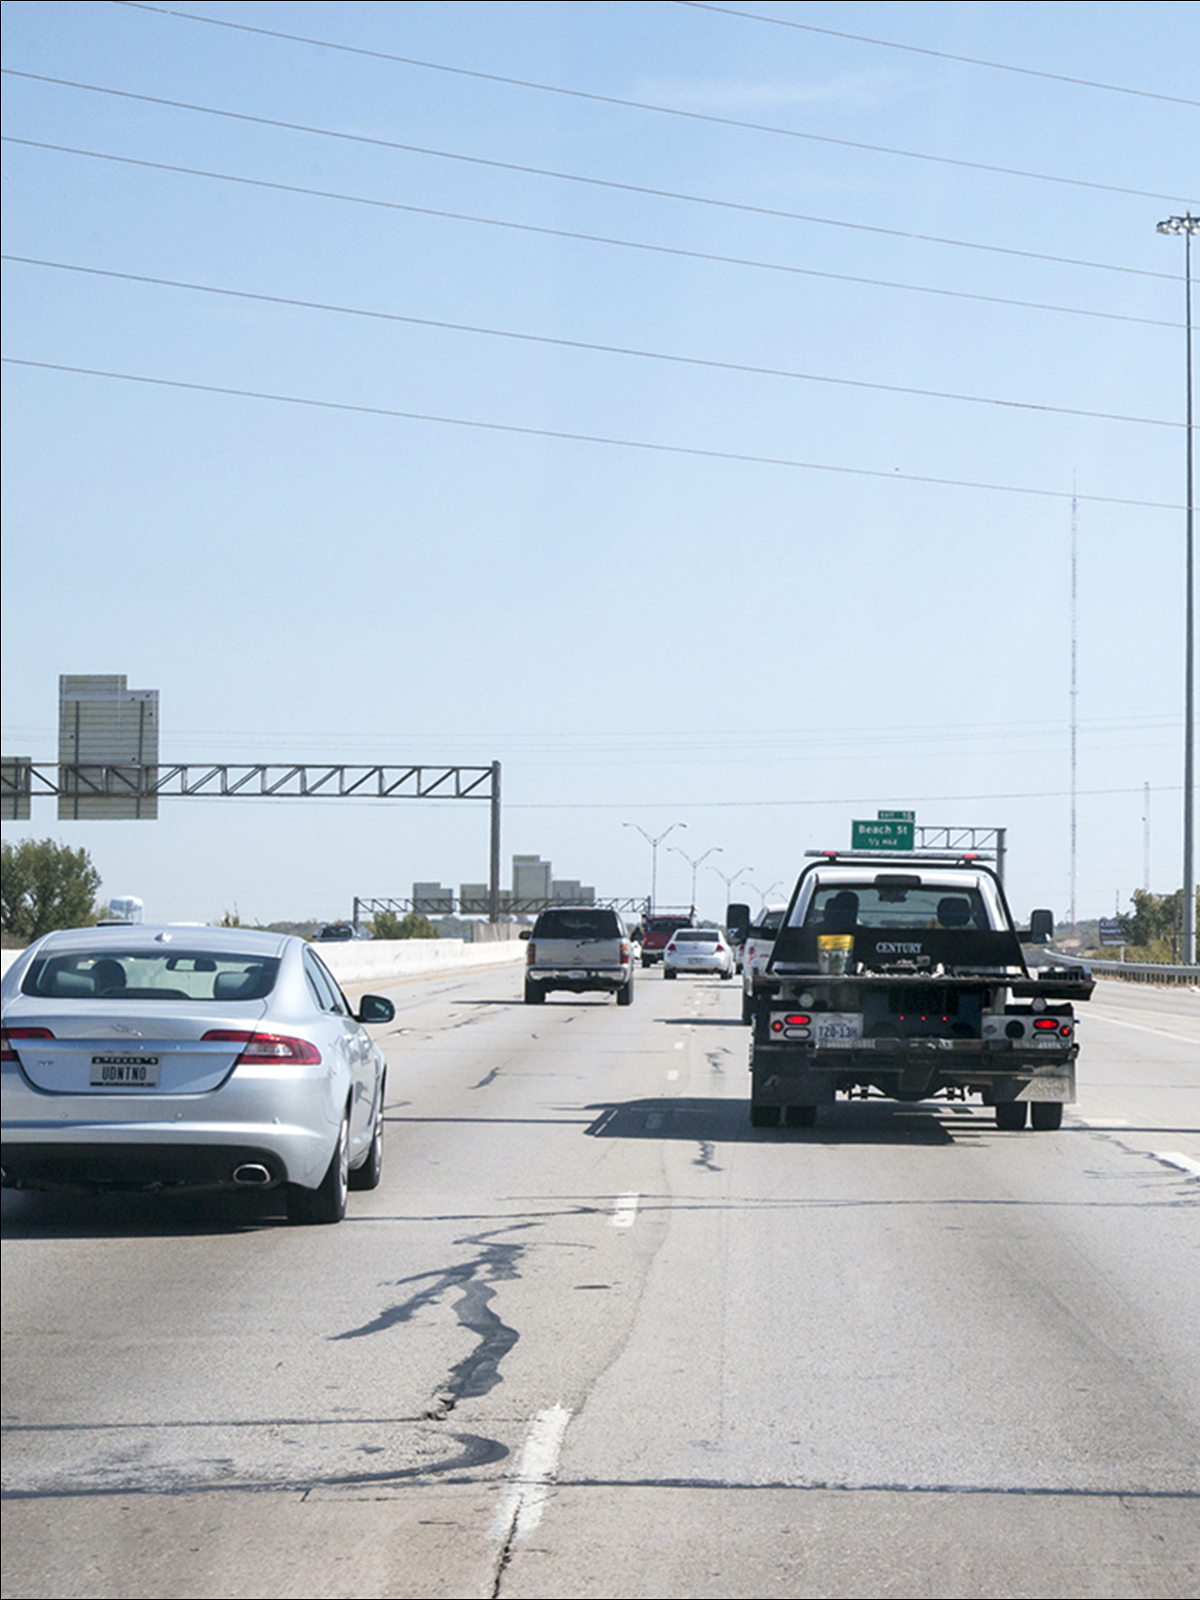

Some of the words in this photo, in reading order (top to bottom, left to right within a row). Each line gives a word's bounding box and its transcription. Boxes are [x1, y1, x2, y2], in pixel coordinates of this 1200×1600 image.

[858, 824, 892, 834] Beach
[896, 825, 908, 834] St
[875, 941, 923, 954] CENTURY
